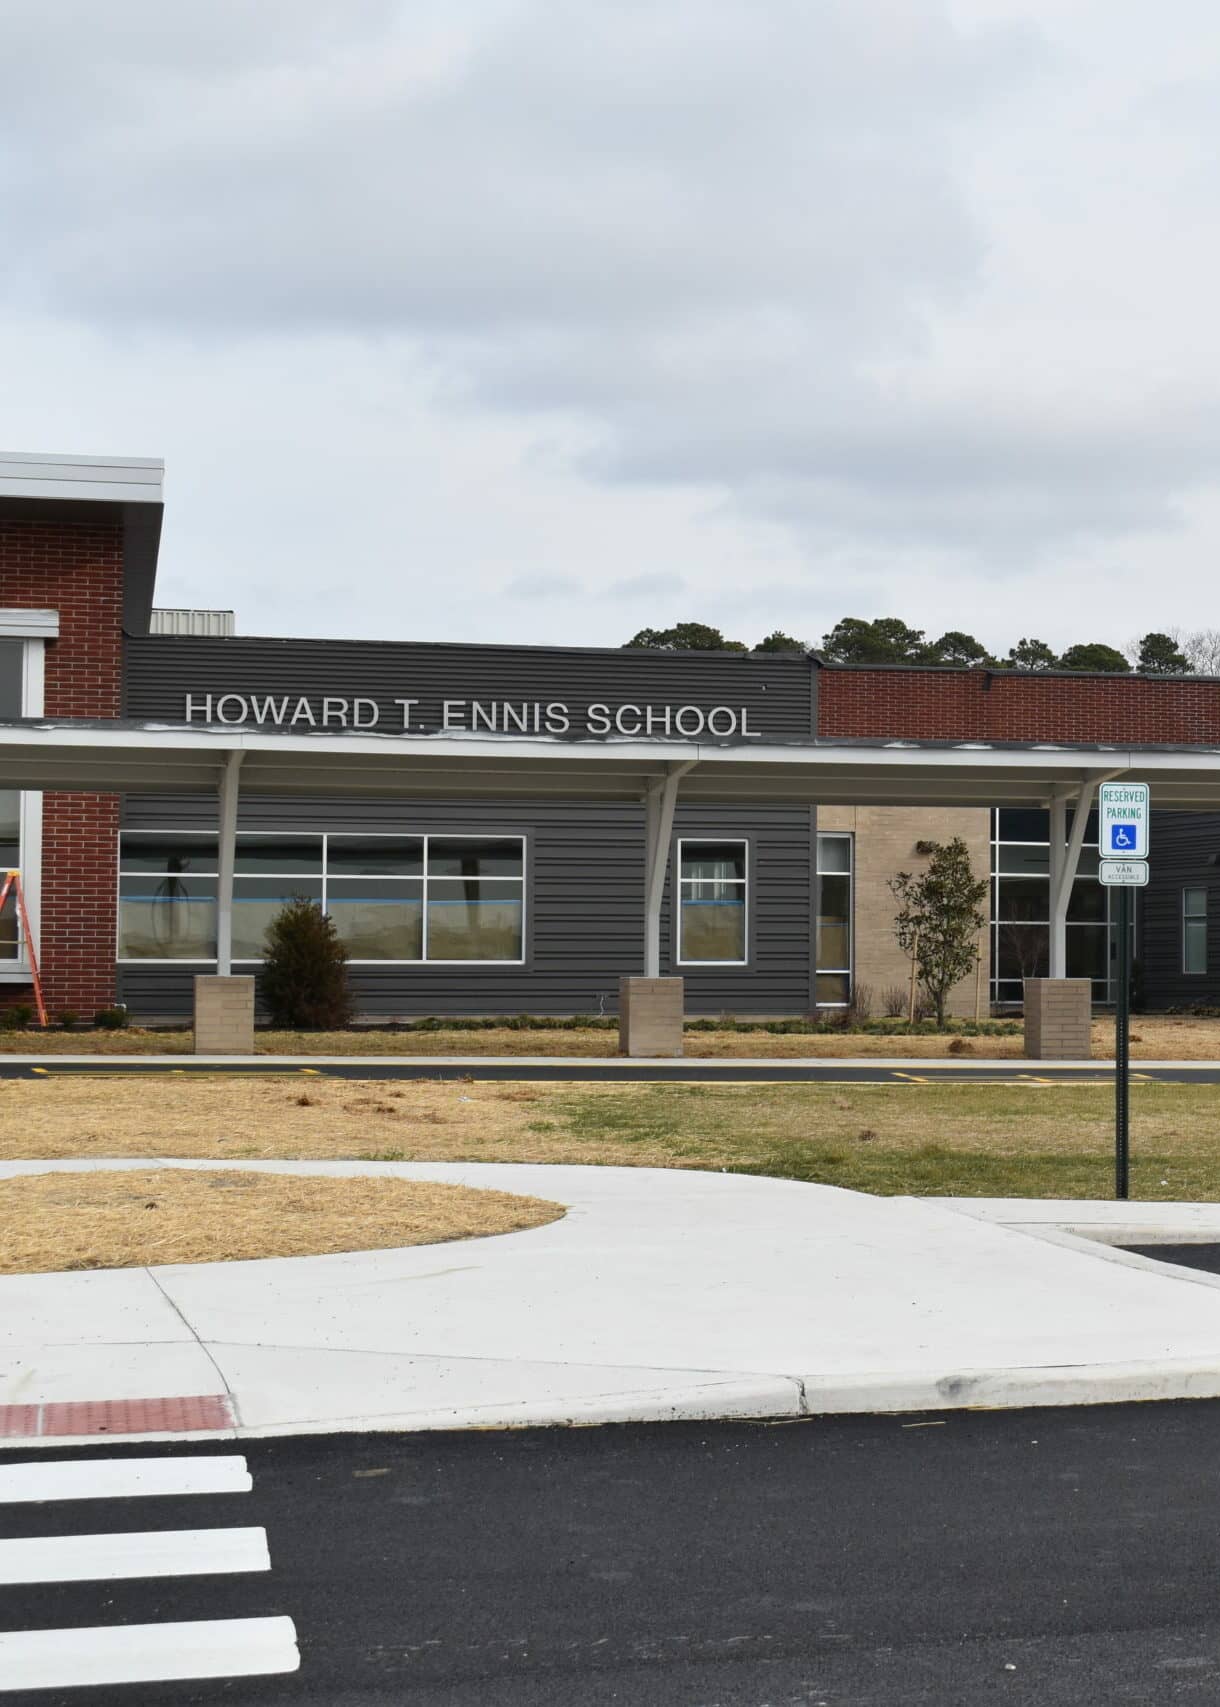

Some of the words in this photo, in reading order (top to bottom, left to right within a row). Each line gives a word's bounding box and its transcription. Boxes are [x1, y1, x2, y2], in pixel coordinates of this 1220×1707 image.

[185, 693, 380, 728] HOWARD
[394, 699, 425, 730] T.
[442, 700, 570, 734] ENNIS
[586, 703, 762, 737] SCHOOL
[1103, 790, 1145, 803] RESERVED
[1106, 807, 1142, 819] PARKING
[1115, 864, 1133, 873] VAN
